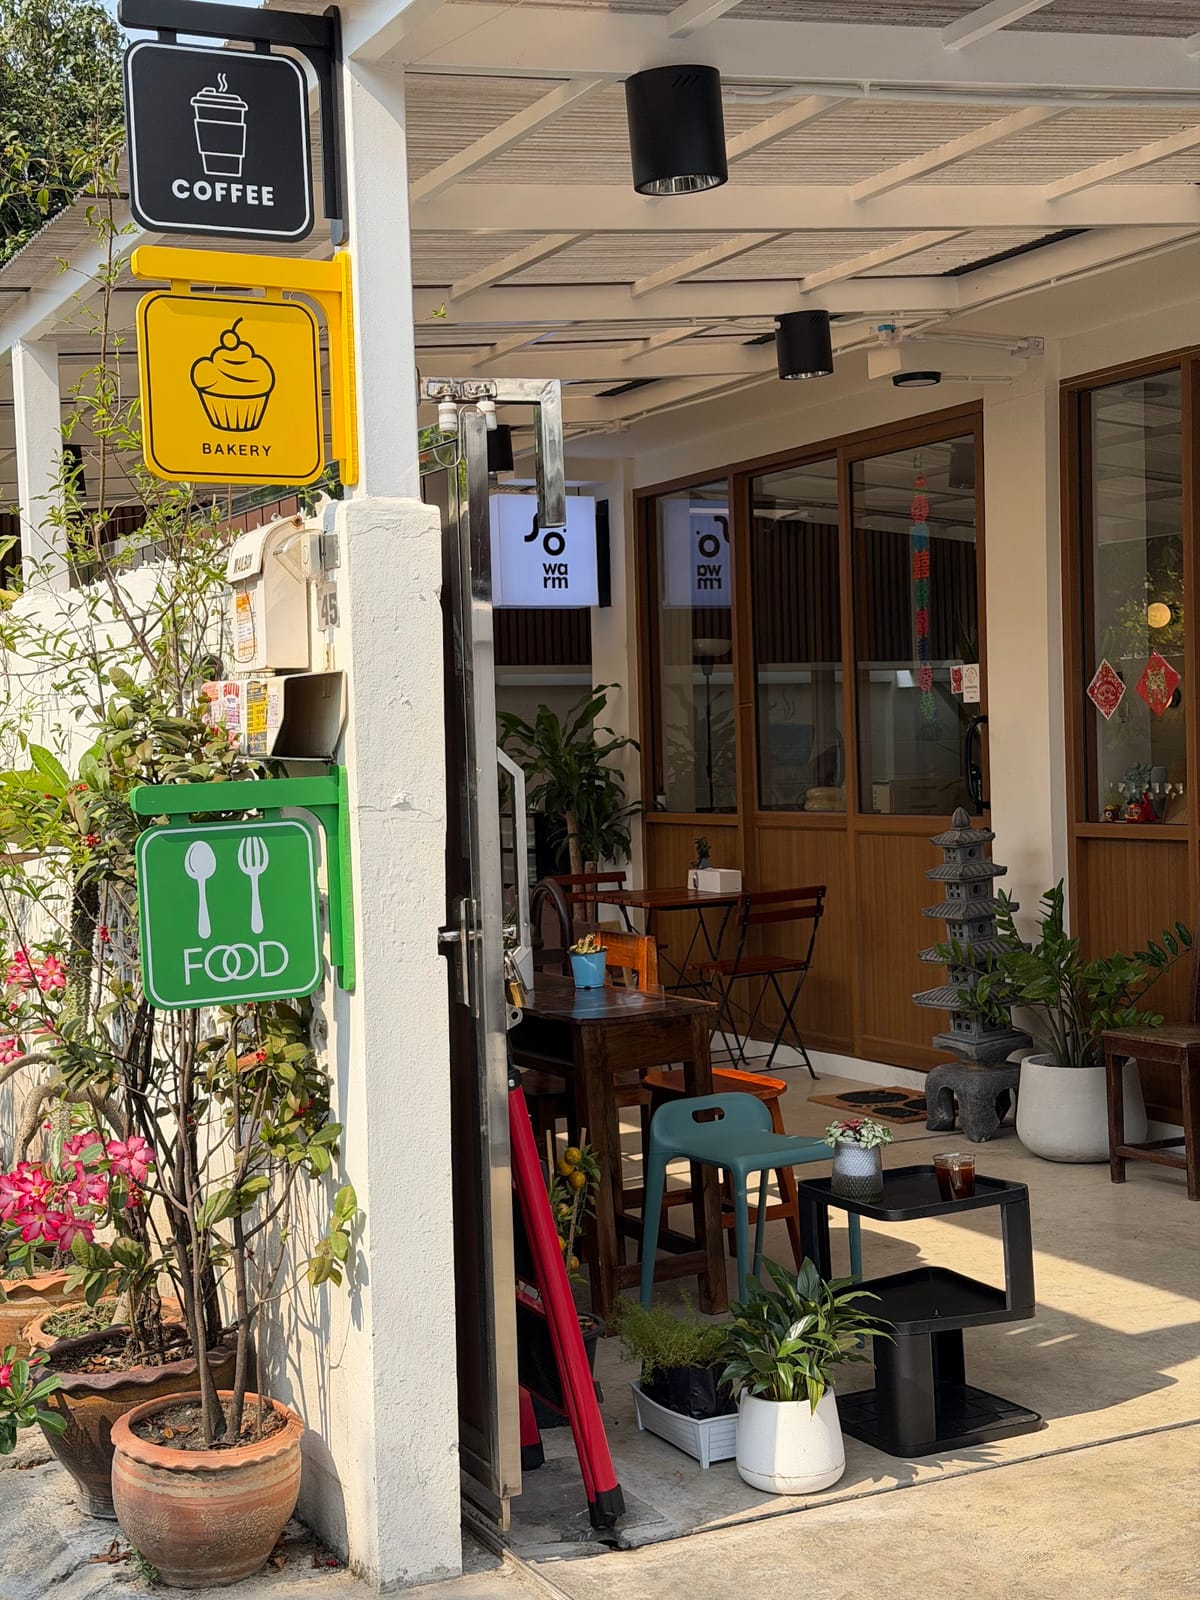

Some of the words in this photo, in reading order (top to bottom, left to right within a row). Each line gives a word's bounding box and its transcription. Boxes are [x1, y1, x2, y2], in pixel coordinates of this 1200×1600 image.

[171, 178, 274, 207] COFFEE
[202, 442, 272, 457] BAKERY
[321, 592, 338, 626] 45
[183, 940, 289, 986] FOOD
